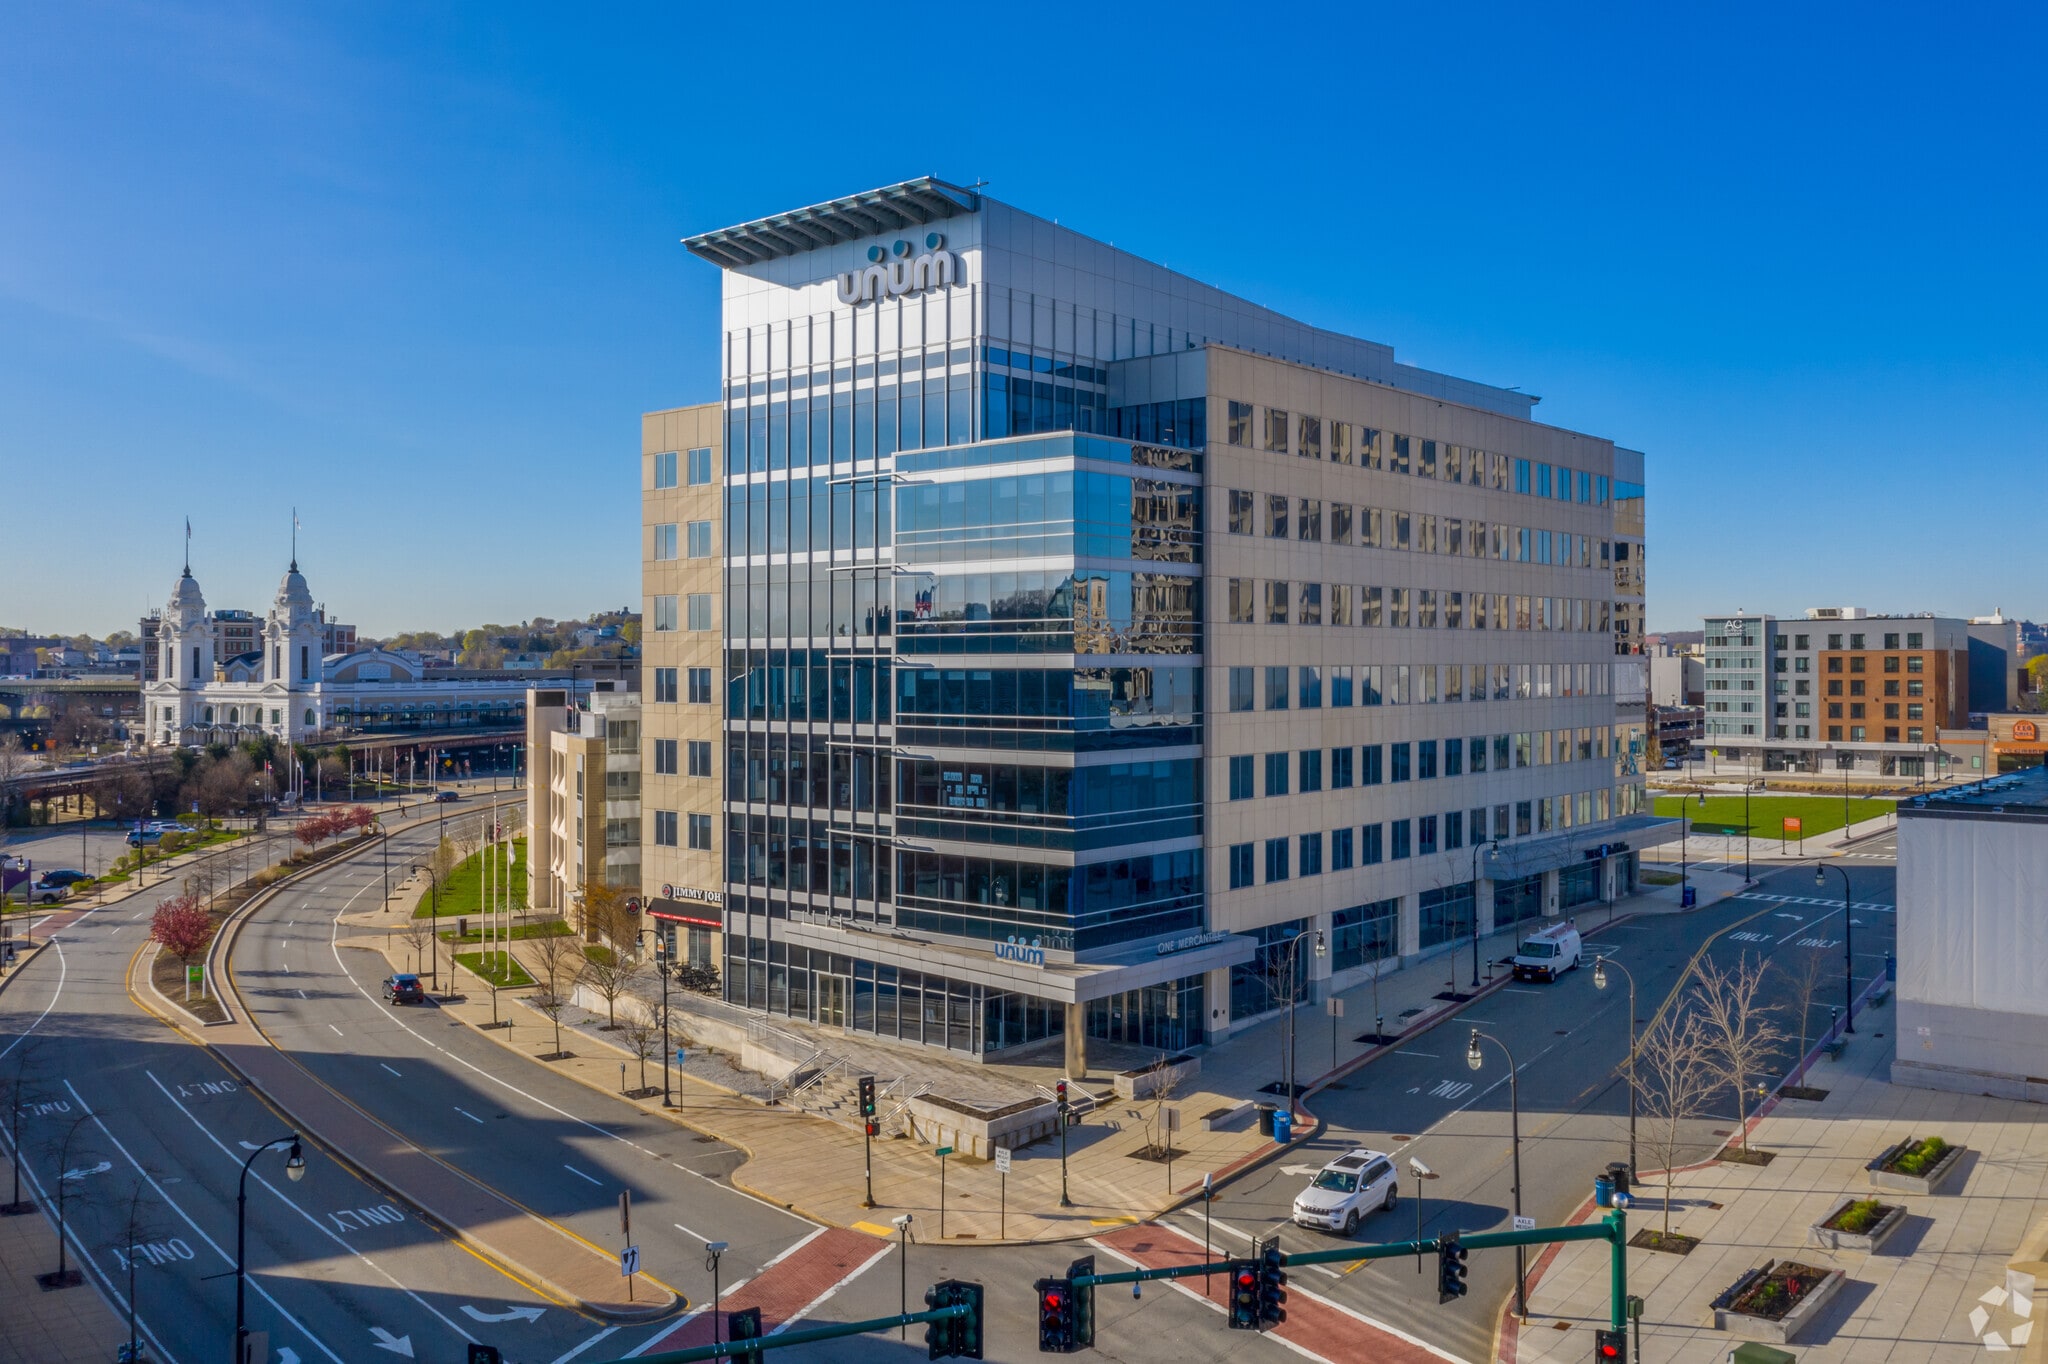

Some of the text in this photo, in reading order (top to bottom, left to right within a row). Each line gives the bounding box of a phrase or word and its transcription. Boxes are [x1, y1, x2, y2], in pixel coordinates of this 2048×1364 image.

[837, 232, 955, 305] unum
[1724, 619, 1743, 630] AC
[673, 886, 702, 899] JIMMY
[1729, 931, 1774, 942] ONLY
[1796, 938, 1842, 948] ONLY
[995, 935, 1045, 966] unum
[1157, 940, 1175, 954] ONE
[327, 1204, 406, 1233] ONLY
[112, 1238, 196, 1271] ONLY
